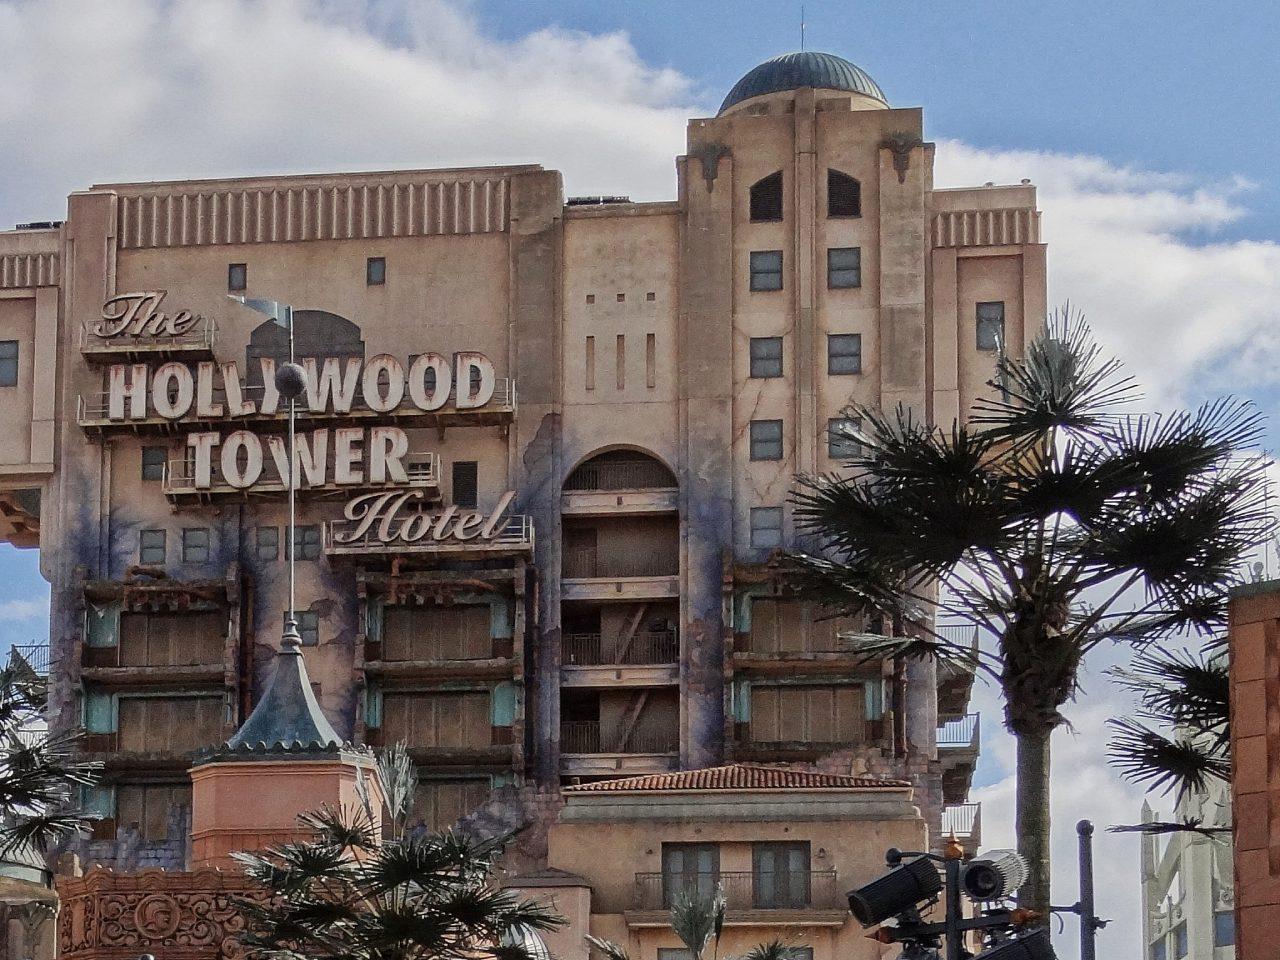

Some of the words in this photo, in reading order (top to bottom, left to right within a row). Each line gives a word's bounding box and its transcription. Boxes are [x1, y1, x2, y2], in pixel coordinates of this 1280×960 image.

[94, 290, 201, 338] The
[108, 351, 496, 421] HOLLYWOOD
[188, 426, 408, 490] TOWER
[334, 490, 517, 543] Hotel
